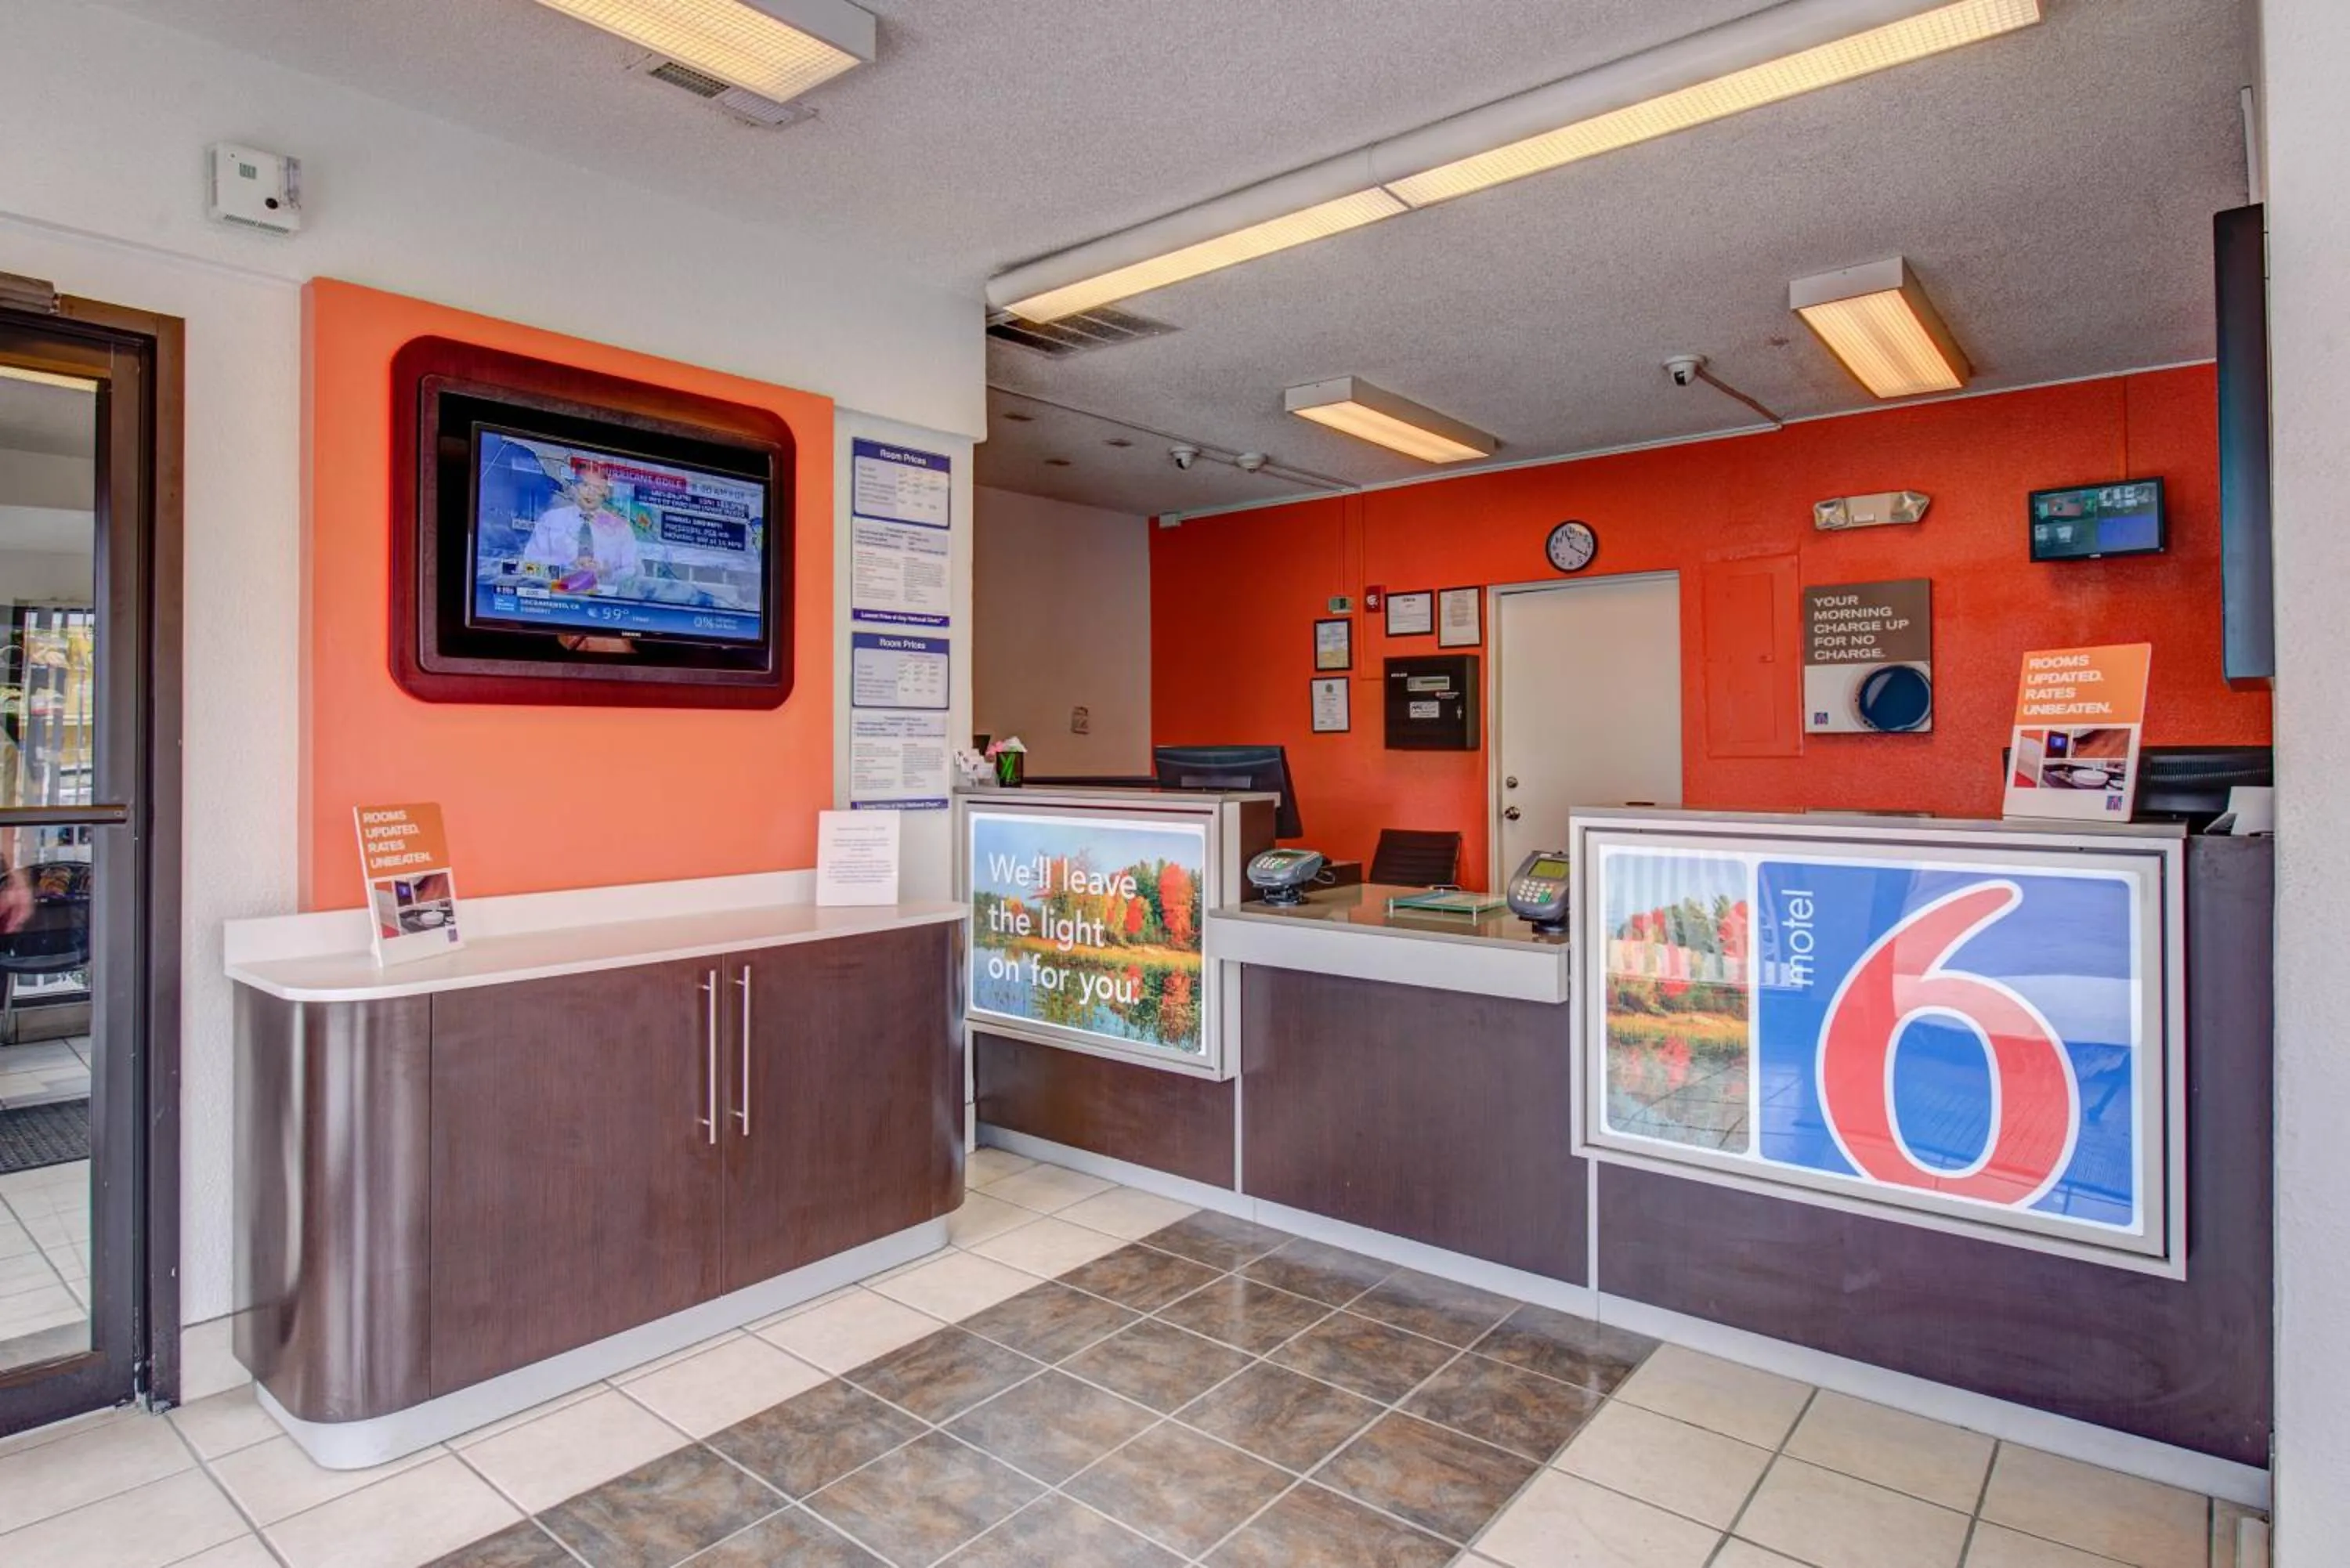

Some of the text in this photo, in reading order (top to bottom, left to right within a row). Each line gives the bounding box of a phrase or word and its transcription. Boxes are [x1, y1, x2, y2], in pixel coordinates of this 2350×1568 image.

[880, 449, 927, 466] Room Prices
[1813, 595, 1859, 607] YOUR
[1813, 607, 1893, 621] MORNING
[1813, 619, 1910, 634] CHARGE UP
[880, 638, 927, 650] Room Prices
[1813, 635, 1875, 647] FOR NO
[1814, 649, 1886, 660] CHARGE.
[2029, 655, 2090, 670] ROOMS
[2026, 670, 2104, 684] UPDATED.
[2025, 687, 2077, 700] RATES
[2023, 702, 2113, 716] UNBEATEN.
[363, 810, 407, 823] ROOMS
[365, 824, 420, 839] UPDATED.
[367, 839, 406, 853] RATES
[370, 851, 433, 869] UNBEATEN.
[989, 852, 1137, 900] We'll leave
[988, 901, 1105, 952] the light
[988, 956, 1019, 983] on
[1030, 954, 1070, 992] for
[1781, 879, 2081, 1211] motel 6
